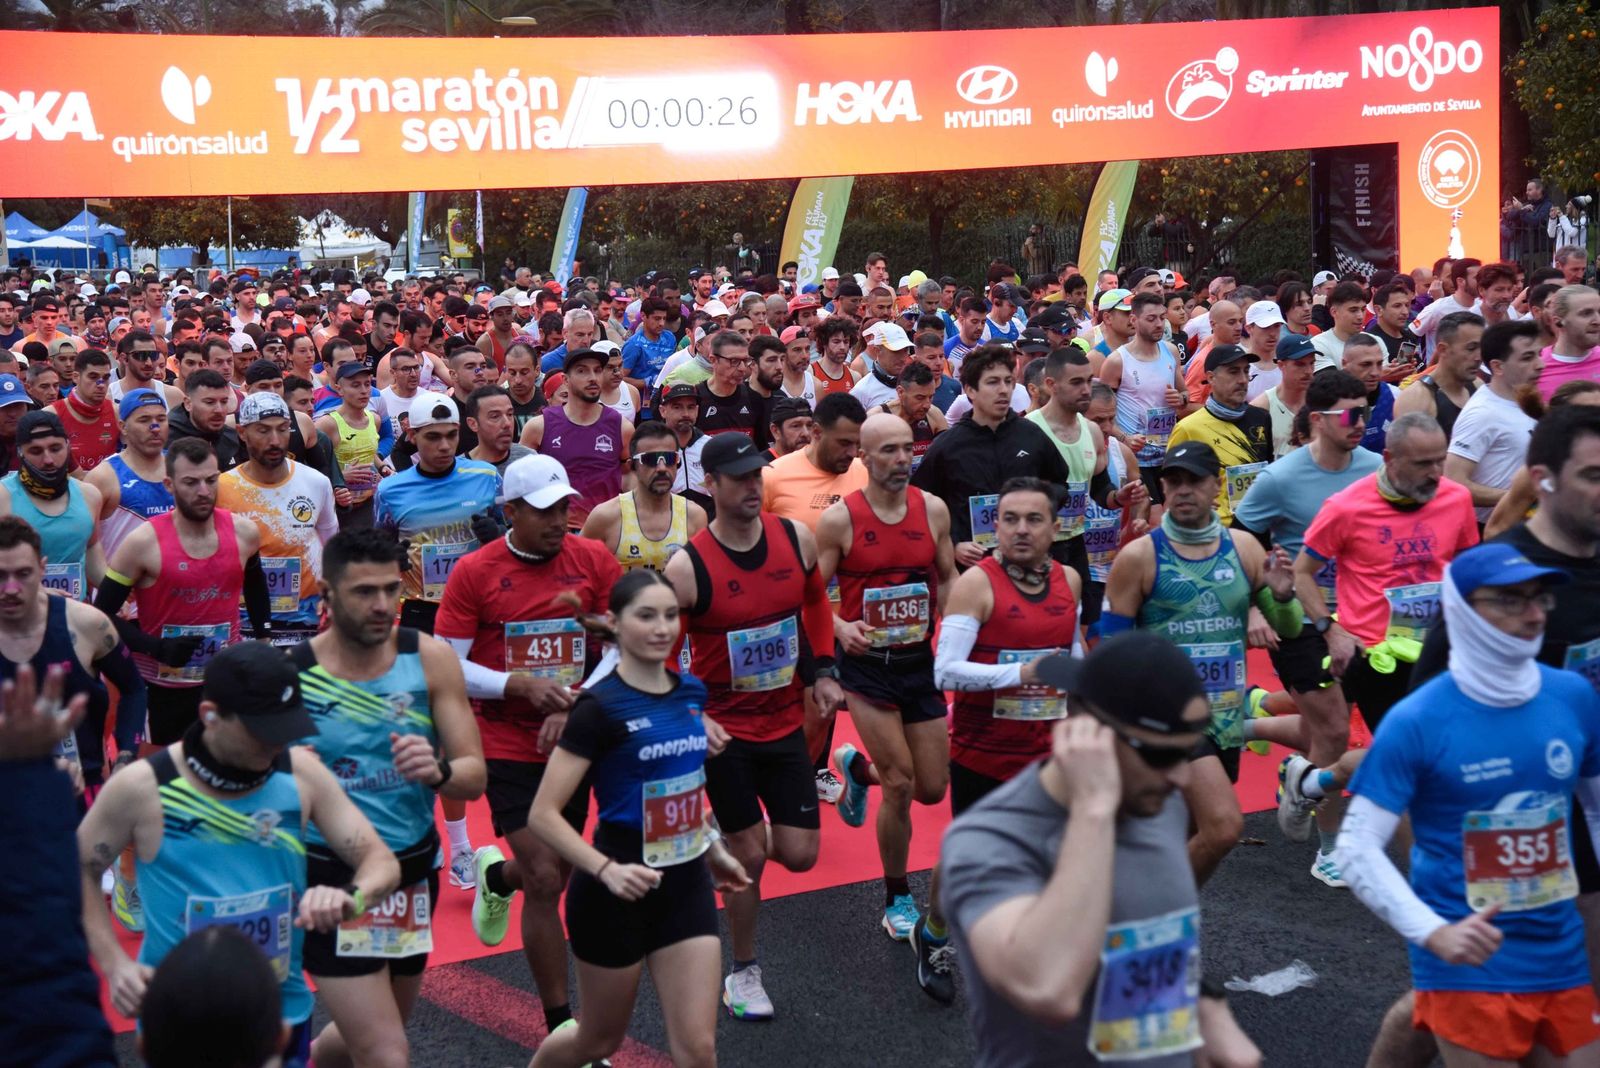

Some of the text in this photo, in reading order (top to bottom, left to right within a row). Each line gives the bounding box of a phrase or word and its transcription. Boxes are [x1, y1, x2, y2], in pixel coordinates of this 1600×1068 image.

[340, 68, 559, 112] maratón
[1245, 68, 1349, 97] Sprinter
[0, 90, 104, 141] OKA
[607, 96, 758, 128] 00:00:26
[795, 79, 922, 126] HOKA
[1052, 100, 1153, 128] quirónsalud
[401, 106, 561, 152] sevilla
[944, 108, 1031, 128] HYUNDAI
[111, 130, 268, 162] quirónsalud
[1354, 163, 1372, 226] FINISH
[1236, 476, 1256, 492] 93
[1085, 531, 1114, 545] 2992
[433, 557, 459, 575] 17
[878, 599, 918, 621] 1436
[1167, 616, 1243, 635] PISTERRA
[527, 636, 563, 659] 431
[742, 638, 786, 666] 2196
[638, 735, 708, 761] enerplus
[664, 794, 698, 827] 917
[1497, 832, 1549, 866] 355
